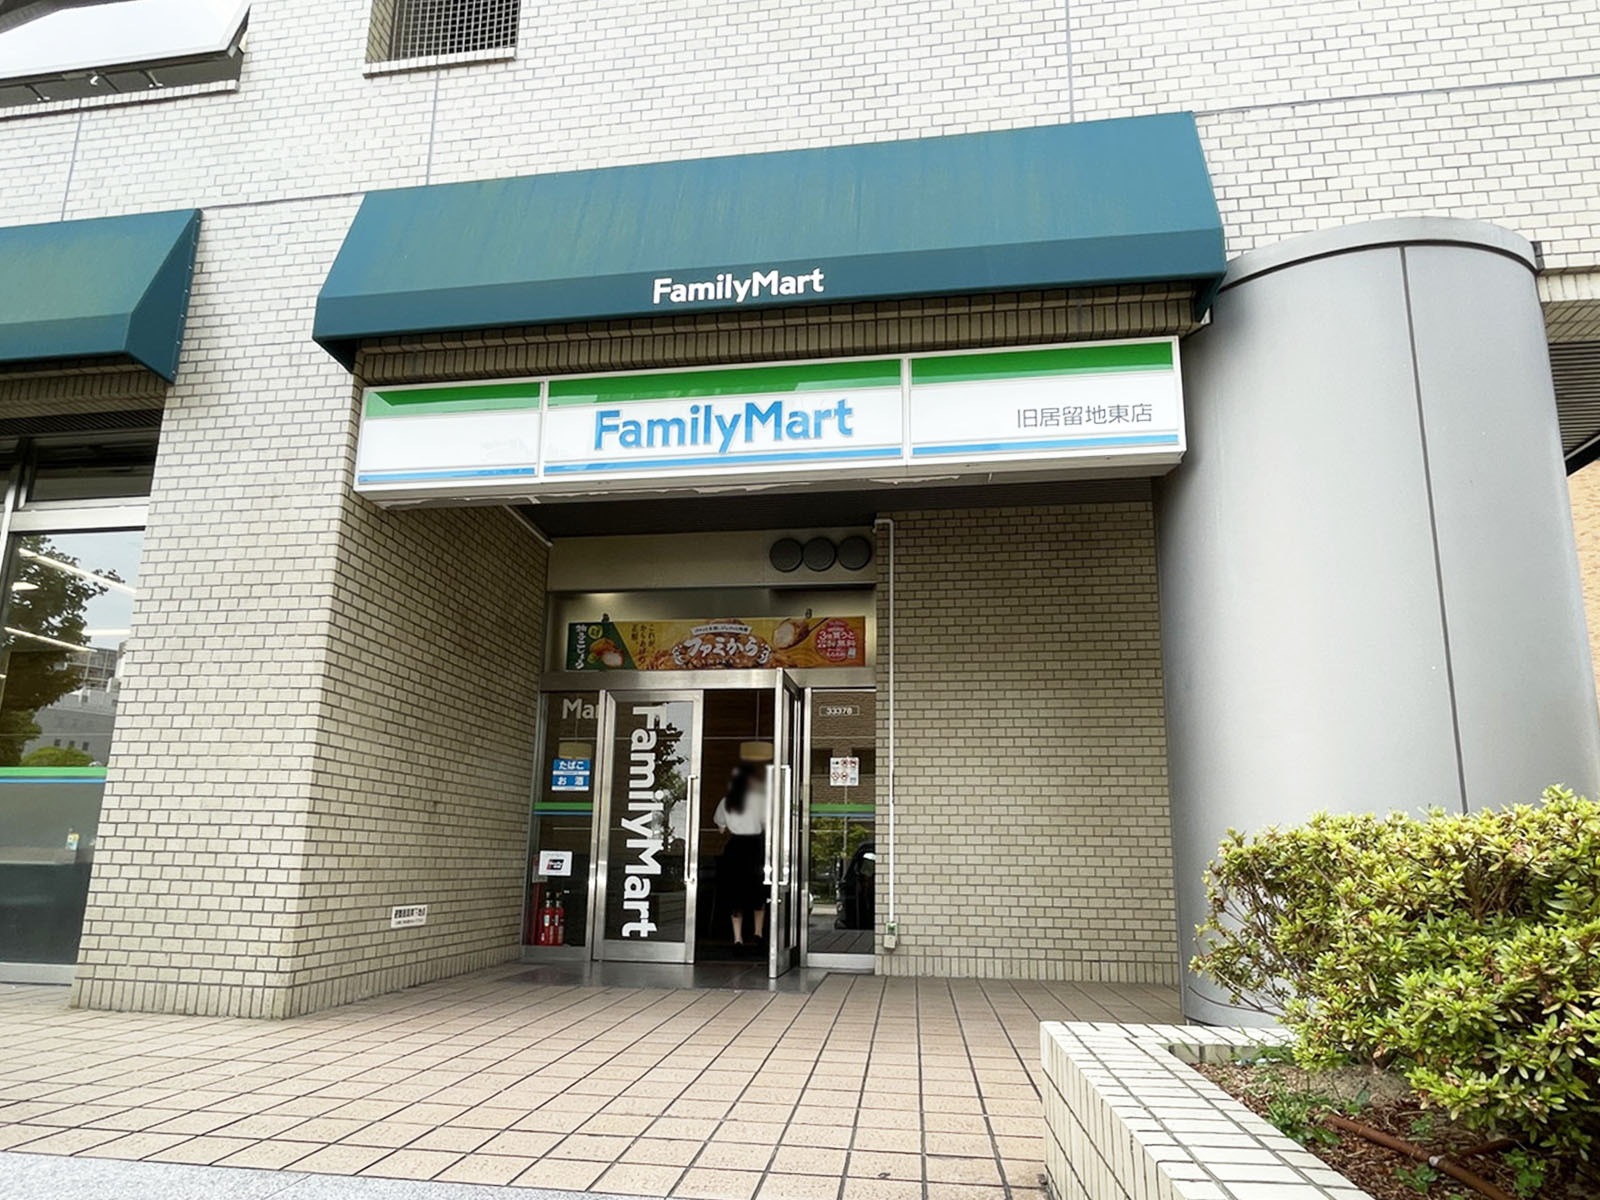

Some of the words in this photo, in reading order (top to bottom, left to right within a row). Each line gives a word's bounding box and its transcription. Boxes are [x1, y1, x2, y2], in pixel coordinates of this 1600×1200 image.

[653, 268, 825, 304] FamilyMart
[594, 399, 854, 454] FamilyMart
[1017, 403, 1153, 428] 旧居留地東店
[558, 760, 585, 770] たばこ
[620, 704, 668, 938] FamilyMart
